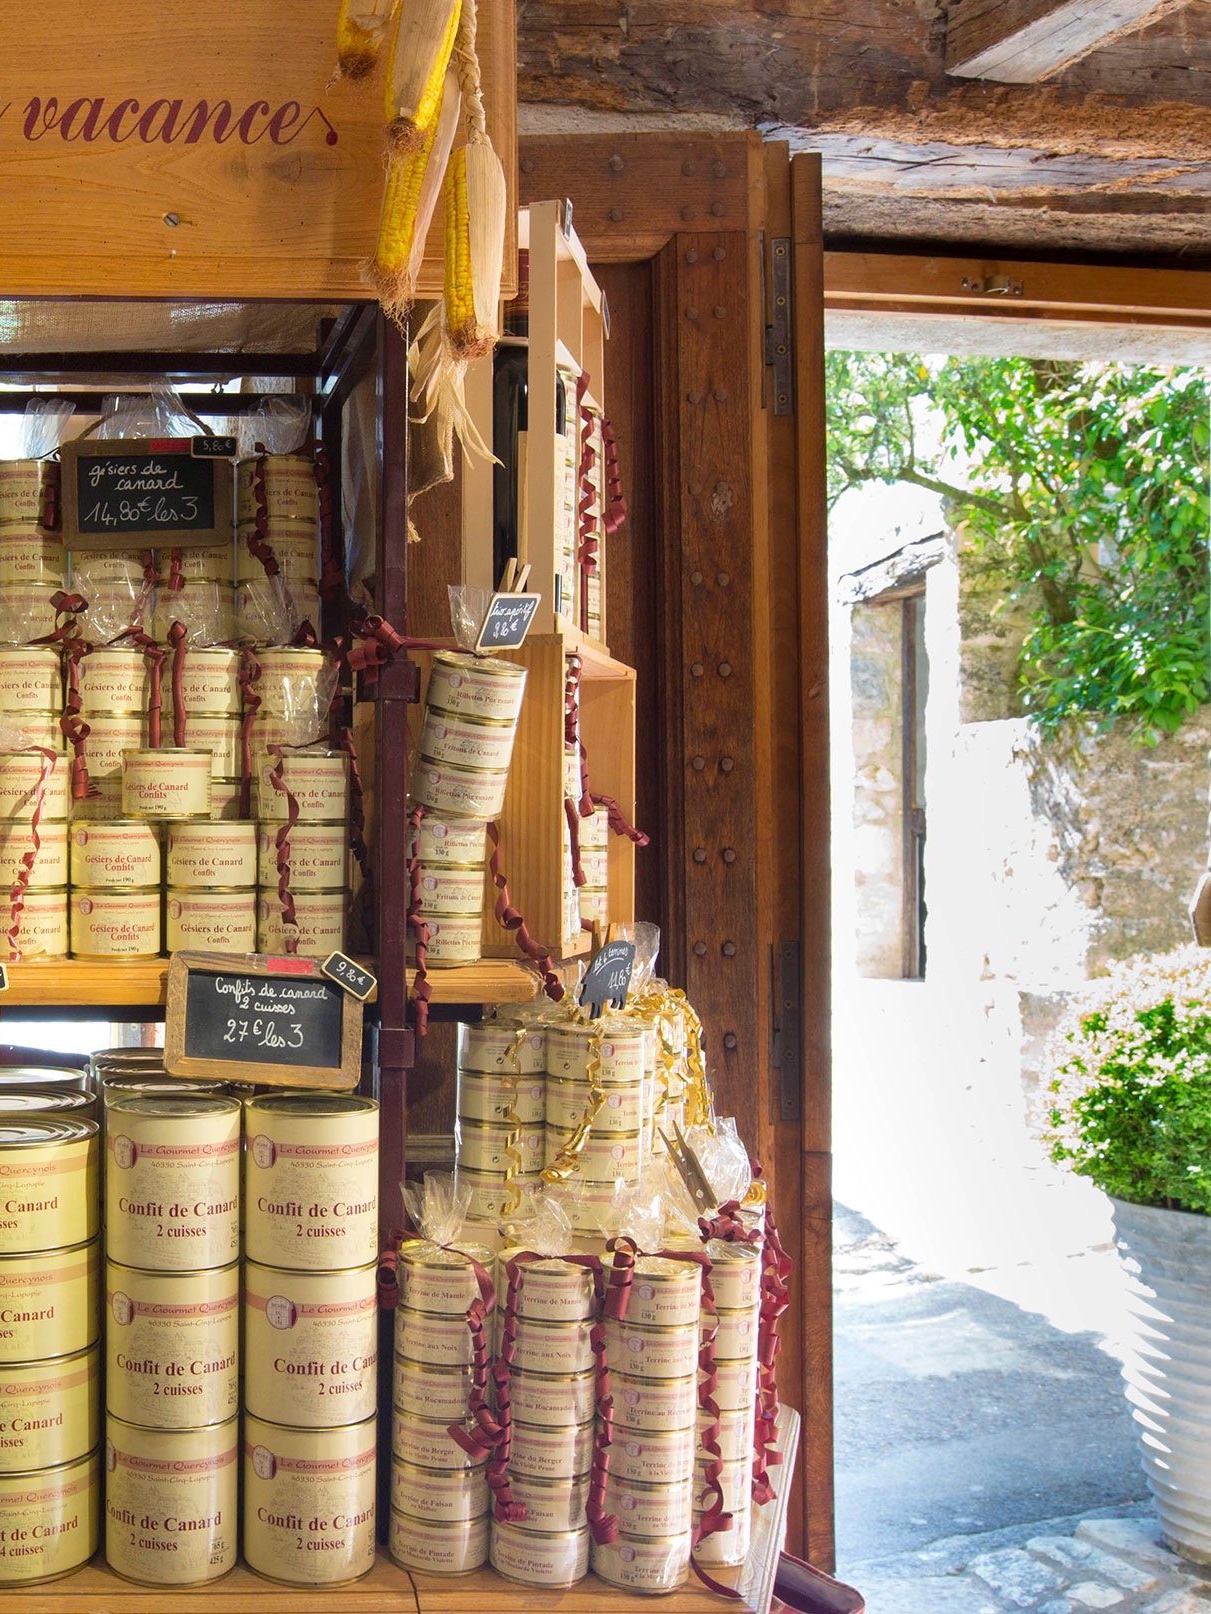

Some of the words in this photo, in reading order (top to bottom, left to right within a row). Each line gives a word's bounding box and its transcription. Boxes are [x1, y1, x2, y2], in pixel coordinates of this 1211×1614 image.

[89, 459, 137, 487] gésiers
[141, 460, 167, 475] de
[115, 475, 184, 491] canard
[148, 498, 178, 522] les
[180, 496, 198, 521] 3
[85, 854, 114, 864] Gésiers
[116, 854, 126, 864] de
[128, 854, 152, 864] Canard
[104, 862, 134, 872] Confits
[215, 977, 255, 1003] Confits
[258, 984, 277, 997] de
[279, 987, 328, 1000] canard
[239, 996, 249, 1009] 2
[254, 1001, 296, 1015] cuisses
[223, 1019, 263, 1043] 27€
[258, 1021, 286, 1047] les
[287, 1024, 304, 1048] 3
[5, 1196, 59, 1213] Canard
[119, 1197, 163, 1217] Confit
[169, 1203, 188, 1218] de
[193, 1196, 238, 1218] Canard
[157, 1224, 163, 1237] 2
[167, 1224, 207, 1238] cuisses
[432, 1291, 440, 1299] de
